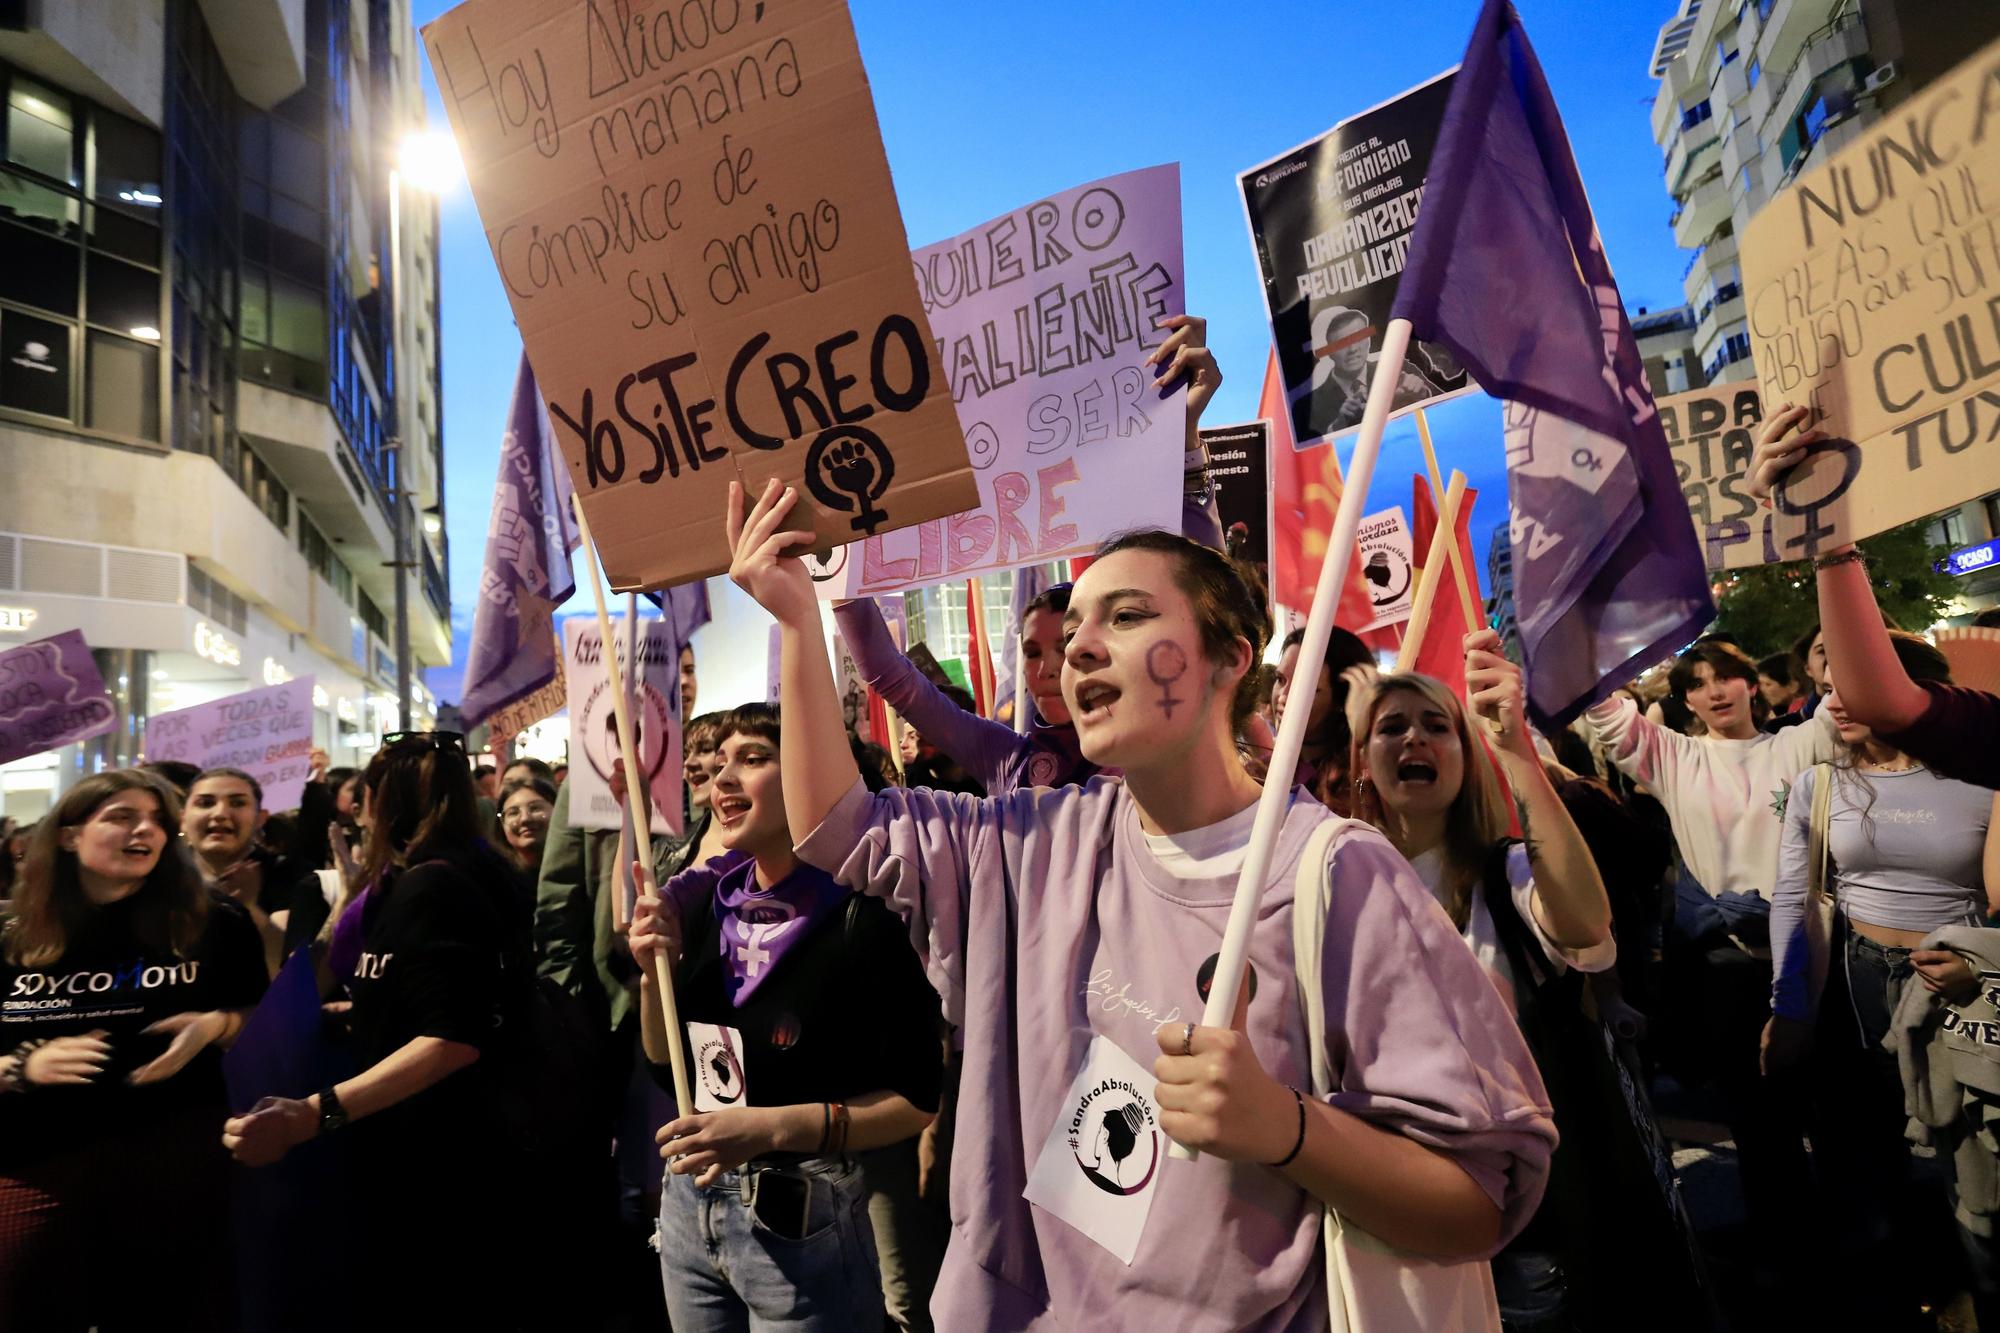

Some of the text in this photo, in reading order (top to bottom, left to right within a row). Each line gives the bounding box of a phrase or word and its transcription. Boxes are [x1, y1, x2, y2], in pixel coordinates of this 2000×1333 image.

[435, 25, 560, 158] Hoy
[590, 38, 802, 176] mañana
[1368, 136, 1383, 150] AL
[499, 136, 758, 298] Cómplice de
[1303, 181, 1426, 269] ORGANIZACI
[1344, 196, 1363, 212] SUS
[1364, 175, 1404, 201] MIGAJAS
[628, 198, 840, 330] su amigo
[1752, 219, 1890, 339] CREAS
[1764, 299, 1863, 405] ABUSO
[1864, 268, 1912, 312] QUE
[725, 315, 931, 450] CREO
[1027, 365, 1152, 455] SER
[1210, 449, 1247, 462] resión
[862, 457, 1080, 586] LIBRE
[1357, 517, 1397, 537] nismos
[1360, 542, 1408, 563] Absolución
[154, 714, 190, 740] POR
[218, 689, 291, 722] TODAS
[202, 721, 262, 749] VECES
[269, 710, 305, 735] QUE
[1078, 969, 1113, 996] Los
[1068, 1078, 1155, 1150] #SandraAbsolución
